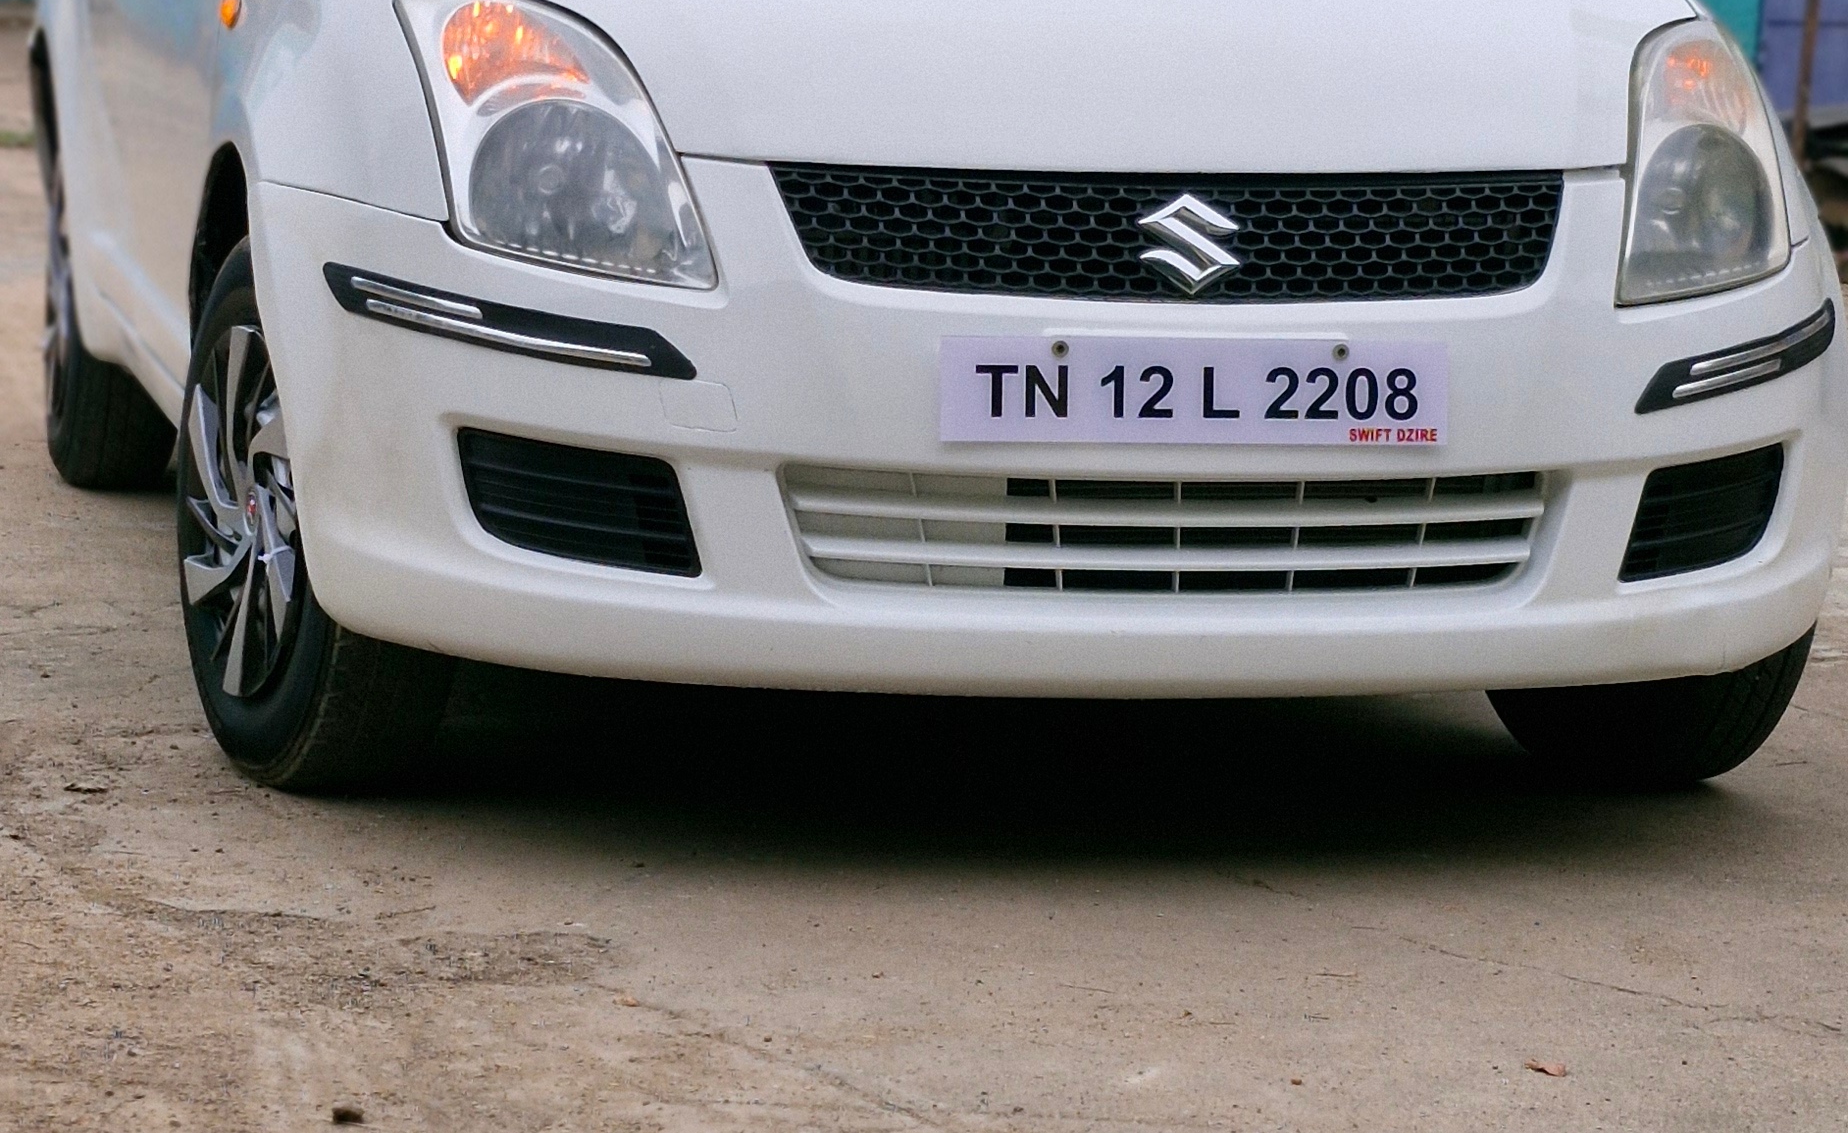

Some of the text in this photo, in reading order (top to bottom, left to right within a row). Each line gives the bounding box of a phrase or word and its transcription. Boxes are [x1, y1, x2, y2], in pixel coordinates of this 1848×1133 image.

[975, 364, 1419, 421] TN 12 L 2208
[1349, 428, 1438, 443] SWIFT DZIRE
